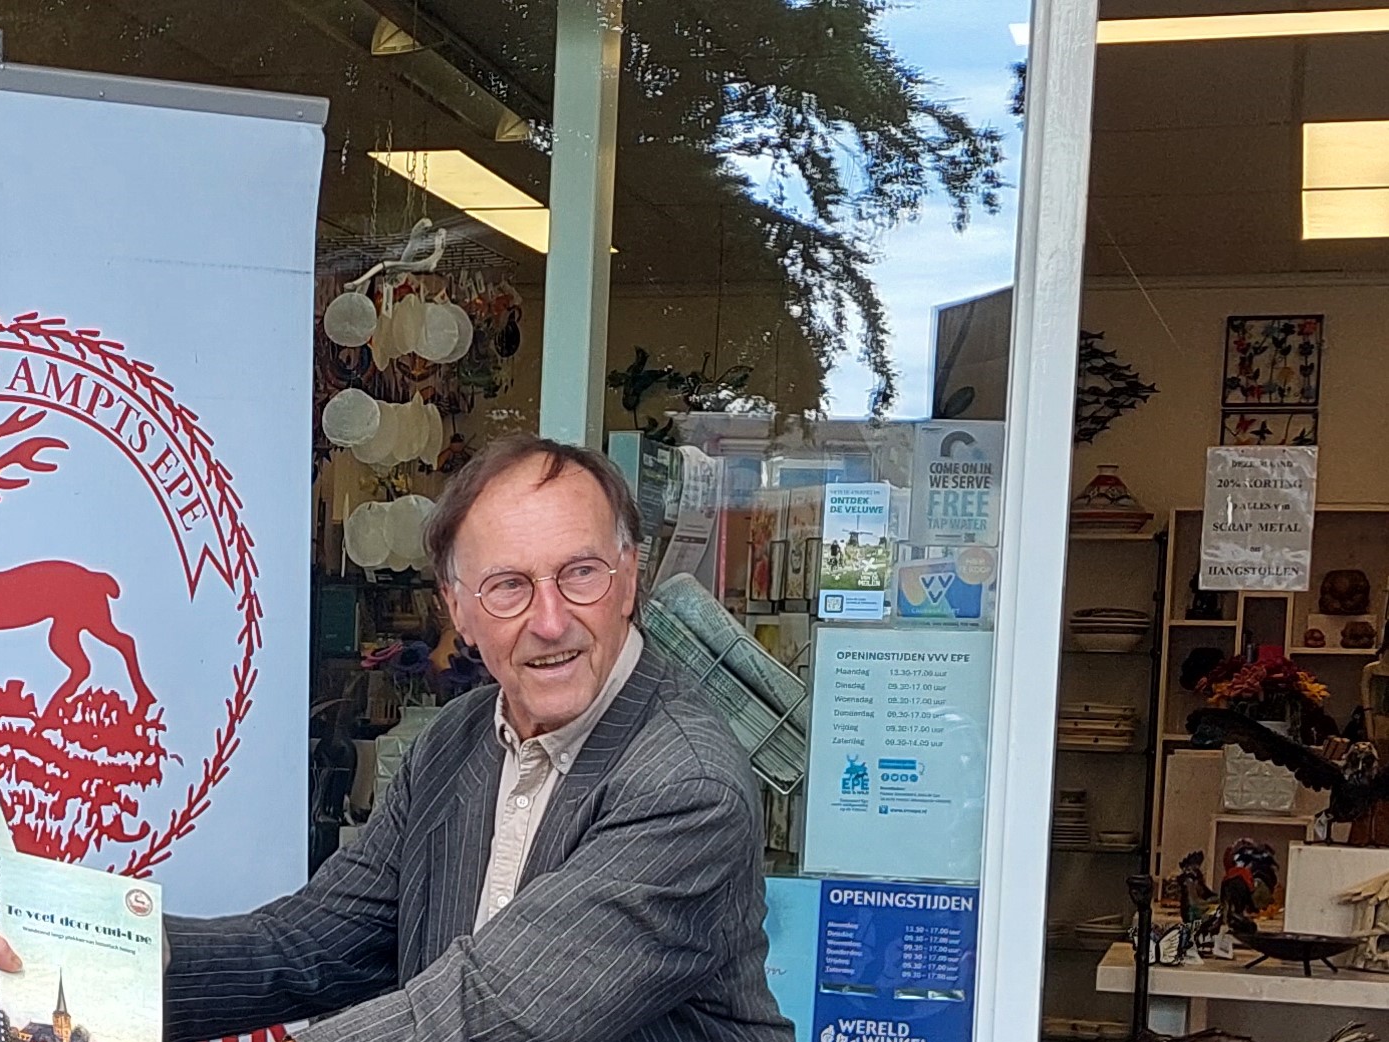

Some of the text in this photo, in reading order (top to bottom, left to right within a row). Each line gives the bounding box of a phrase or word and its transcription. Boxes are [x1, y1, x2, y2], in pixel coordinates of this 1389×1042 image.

[5, 357, 156, 454] AMPTS
[147, 443, 209, 532] EPE
[929, 462, 959, 475] COME
[961, 463, 978, 475] ON
[929, 475, 991, 489] WE SERVE
[1217, 479, 1241, 488] 20%
[830, 496, 869, 505] ONTDEK
[927, 490, 990, 517] FREE
[830, 505, 884, 514] DE VELUWE
[927, 517, 987, 531] TAP WATER
[1212, 521, 1301, 533] SCRAP METAL
[836, 651, 970, 662] OPENINGSTIJDEN VVV EPE
[841, 778, 870, 791] EPE
[829, 889, 974, 912] OPENINGSTIJDEN
[838, 1018, 910, 1037] WERELD
